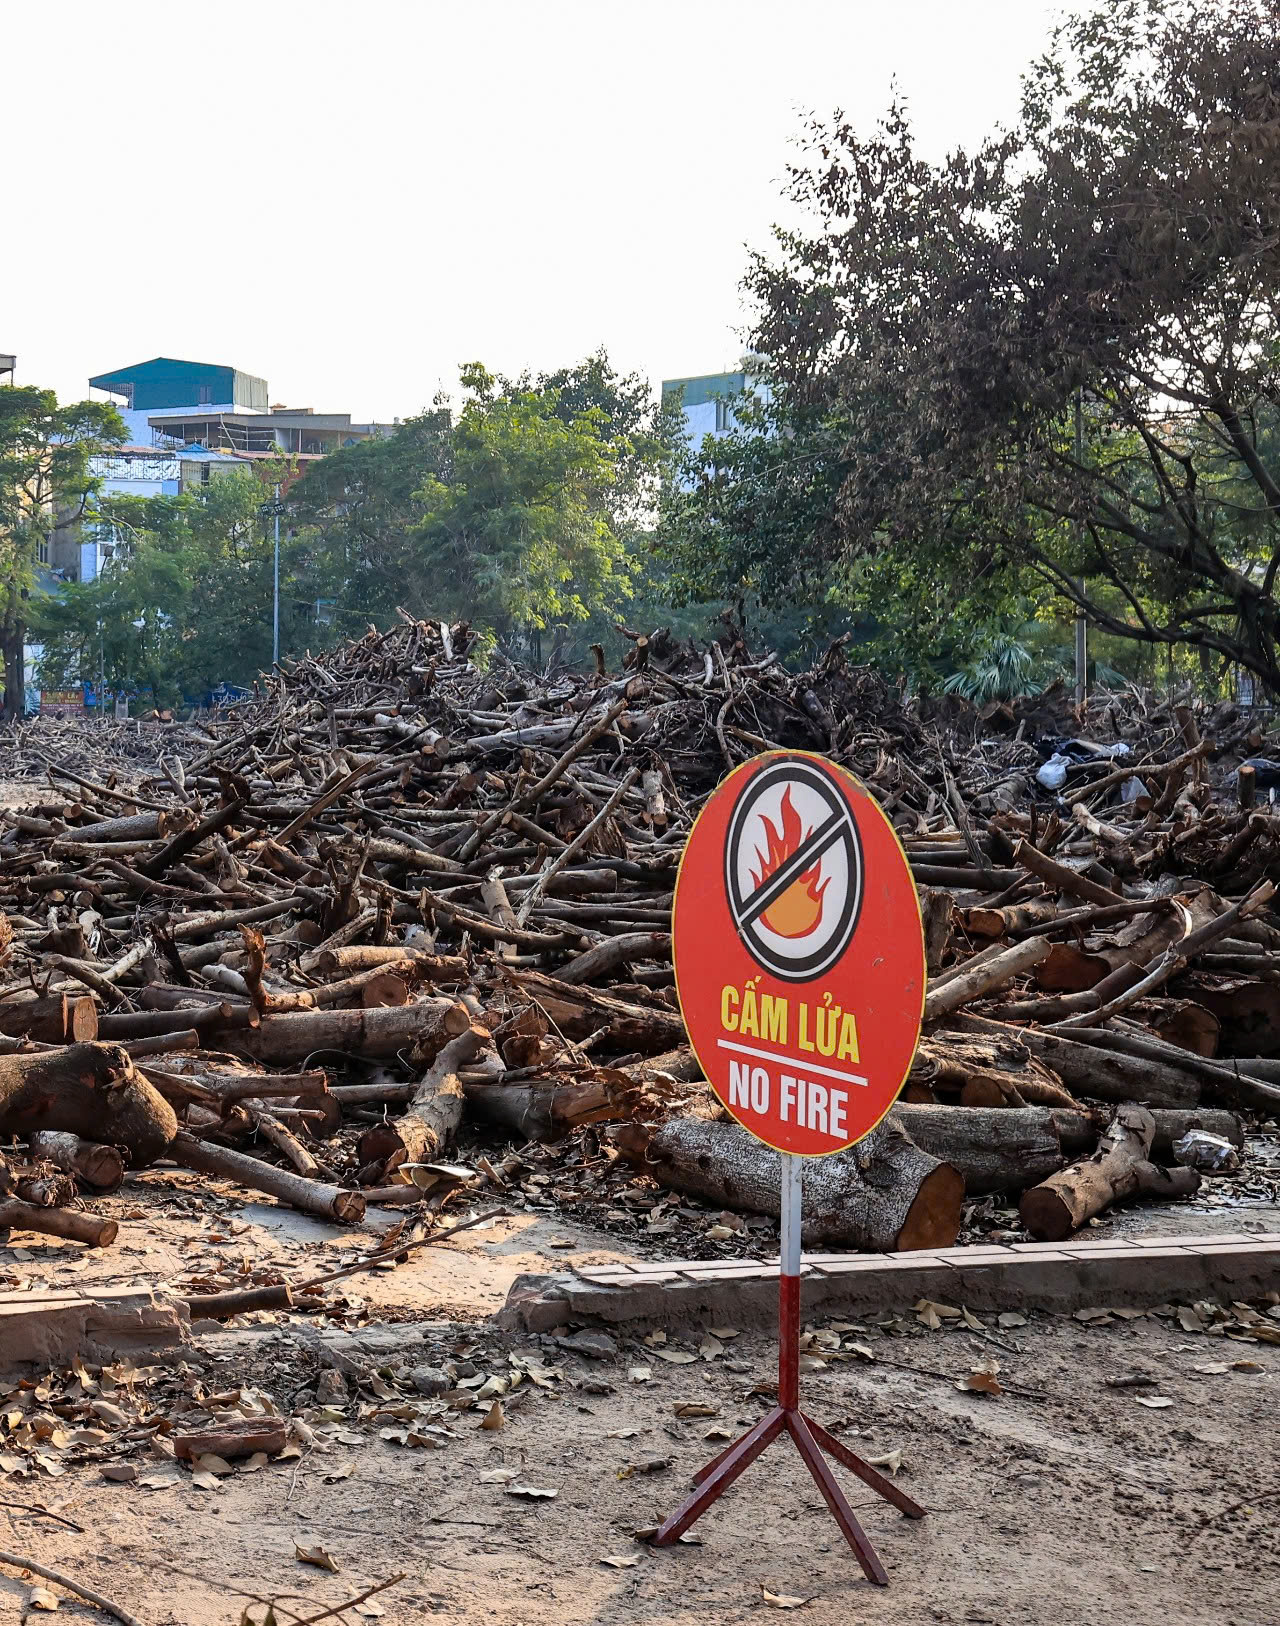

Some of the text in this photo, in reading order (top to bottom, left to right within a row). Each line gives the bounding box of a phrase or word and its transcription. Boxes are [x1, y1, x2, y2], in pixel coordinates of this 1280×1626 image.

[721, 975, 860, 1064] CẤM LỬA
[729, 1059, 848, 1140] NO FIRE
